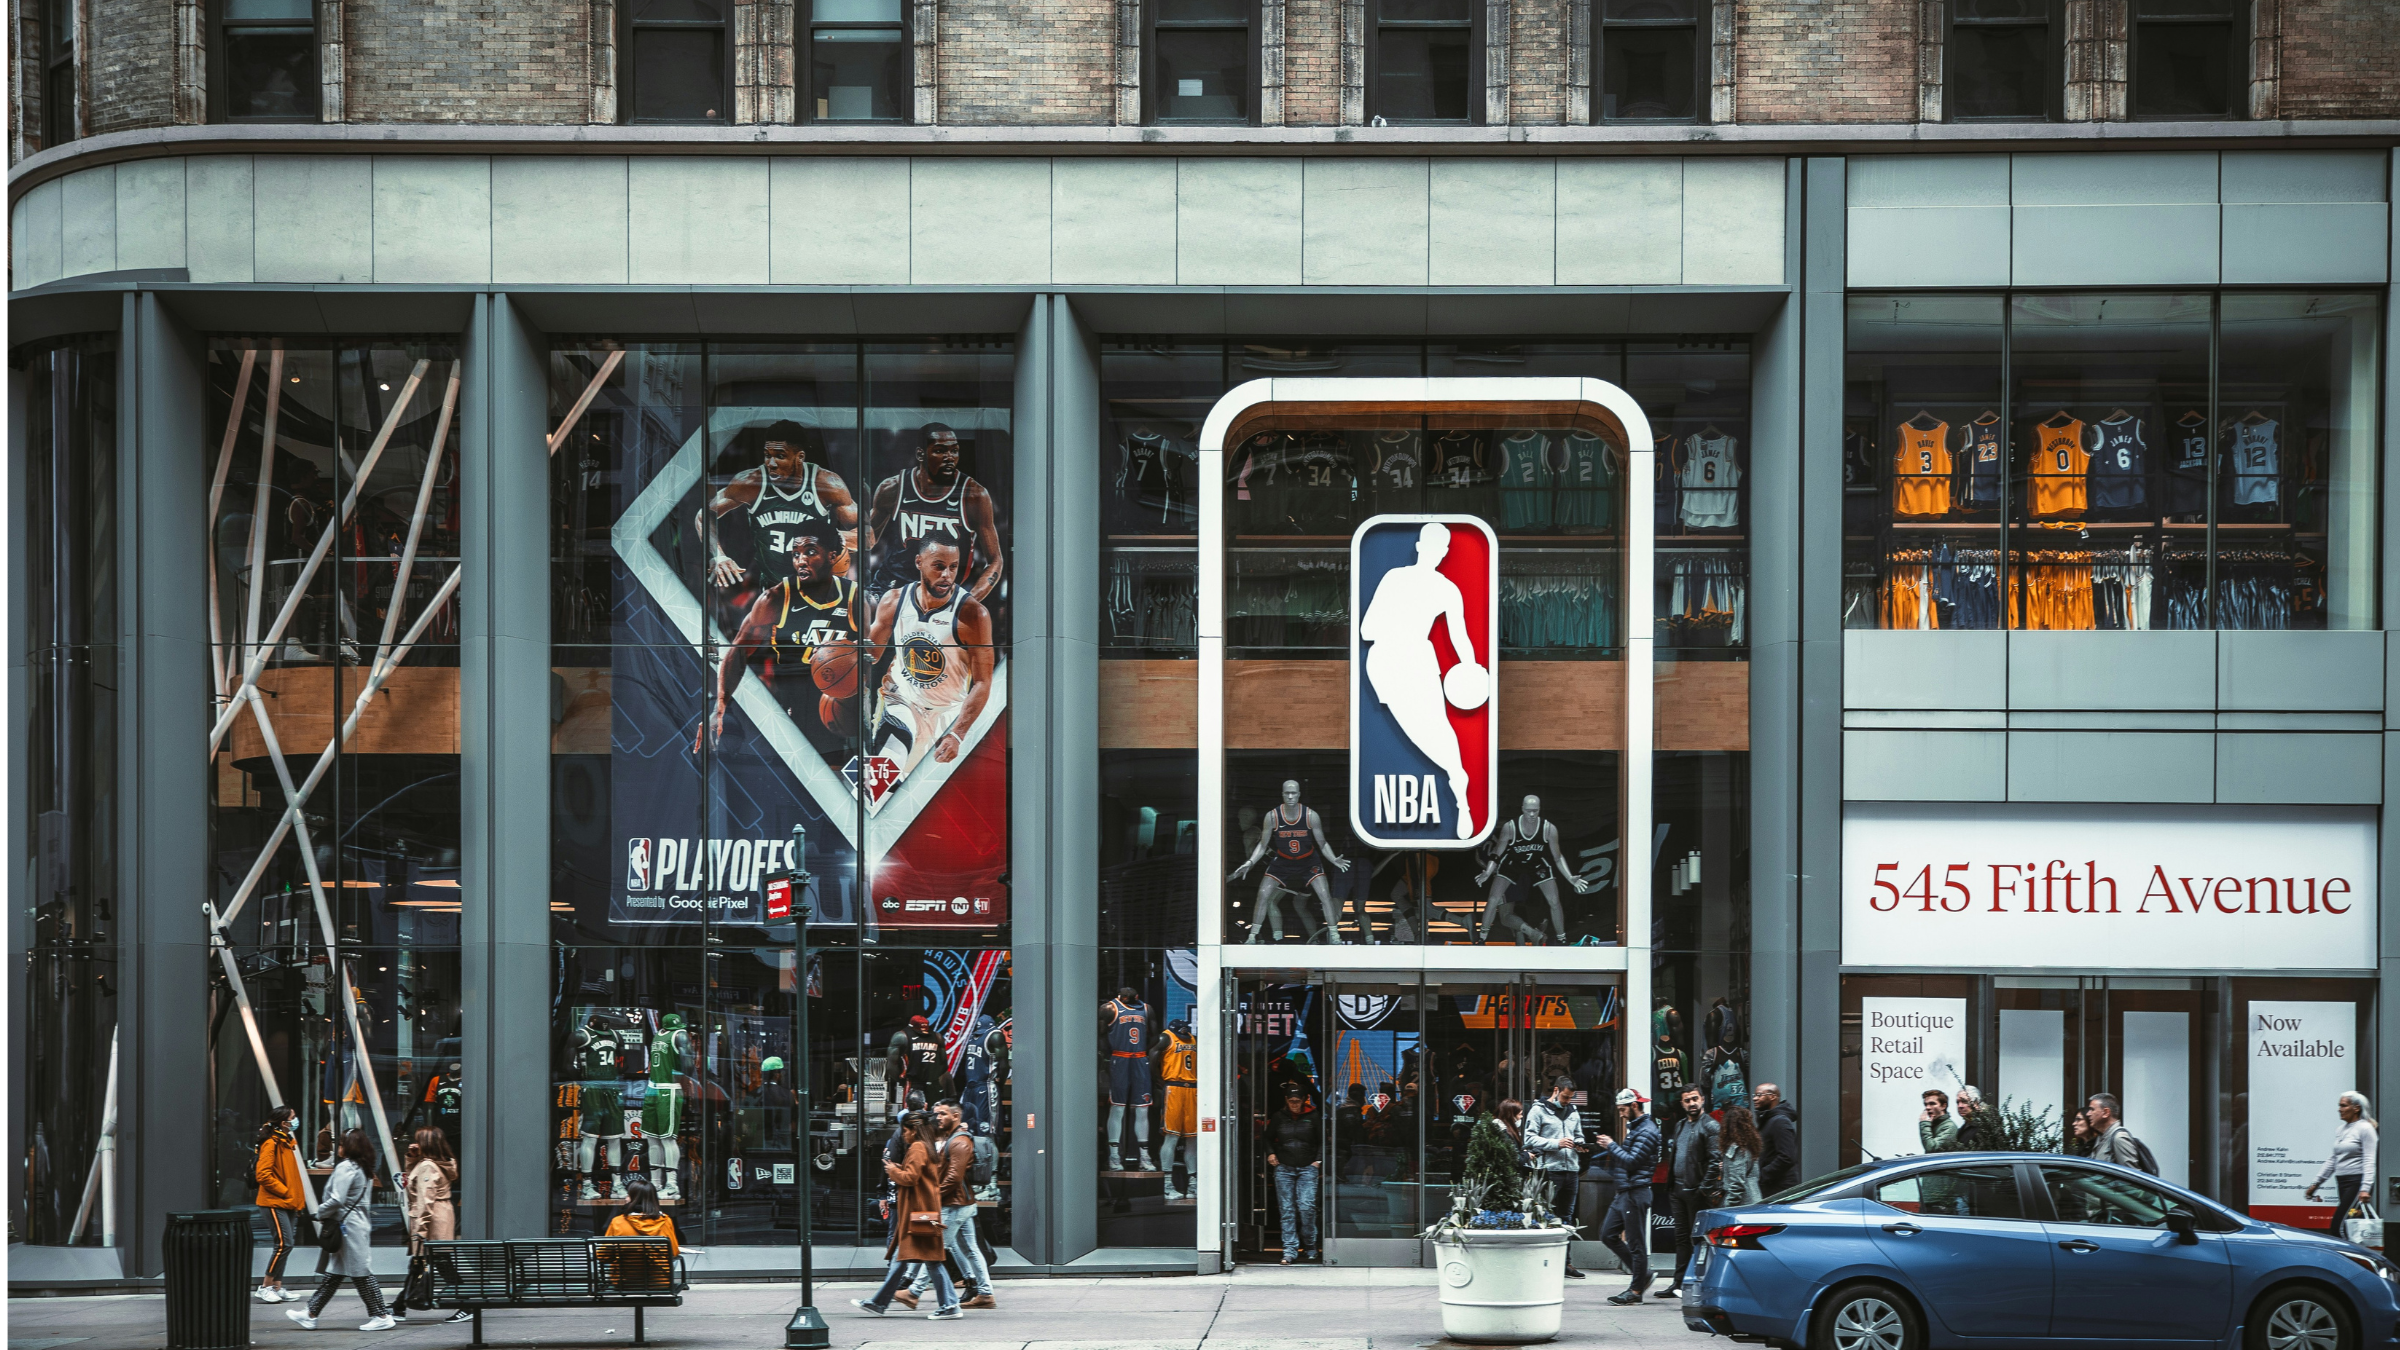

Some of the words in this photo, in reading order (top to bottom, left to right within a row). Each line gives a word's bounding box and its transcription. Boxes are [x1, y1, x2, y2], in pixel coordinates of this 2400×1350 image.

[1917, 439, 1934, 448] DAVIS
[2046, 437, 2076, 453] WESTBROOK
[2109, 435, 2133, 447] JAMES
[2183, 436, 2206, 459] 13
[1133, 447, 1155, 459] DURANT
[1517, 450, 1534, 460] BALL
[1578, 449, 1594, 459] BALL
[1701, 449, 1720, 459] JAMES
[1977, 442, 1999, 463] 23
[2056, 448, 2070, 472] 0
[2116, 447, 2131, 471] 6
[2244, 446, 2267, 469] 12
[1136, 459, 1148, 481] 7
[1920, 450, 1933, 474] 3
[1308, 465, 1332, 487] 34
[1389, 466, 1414, 488] 34
[1447, 466, 1470, 488] 34
[1520, 461, 1535, 483] 2
[1579, 461, 1593, 482] 2
[1703, 460, 1716, 483] 6
[756, 511, 815, 528] MILWAUK
[922, 649, 940, 663] 30
[901, 668, 949, 690] WARRIORS
[1374, 774, 1441, 823] NBA
[1289, 839, 1300, 854] 9
[1513, 843, 1545, 854] BROOKLYN
[1525, 852, 1533, 860] 7
[1868, 860, 1972, 912] 545
[1987, 859, 2122, 914] Fifth
[2136, 864, 2353, 915] Avenue
[626, 895, 658, 908] Presented
[719, 896, 749, 909] Pixel
[882, 900, 900, 909] abc
[905, 899, 947, 912] ESPN
[1870, 1011, 1955, 1032] Boutique
[2256, 1014, 2302, 1031] Now
[1129, 1027, 1140, 1045] 9
[1870, 1036, 1924, 1054] Retail
[912, 1042, 939, 1052] MIAMI
[2256, 1039, 2345, 1058] Available
[598, 1050, 616, 1066] 34
[652, 1052, 661, 1068] 0
[921, 1051, 937, 1063] 22
[1660, 1071, 1683, 1090] 33
[1870, 1062, 1924, 1083] Space
[1731, 1085, 1745, 1095] 32
[628, 1154, 640, 1171] 4
